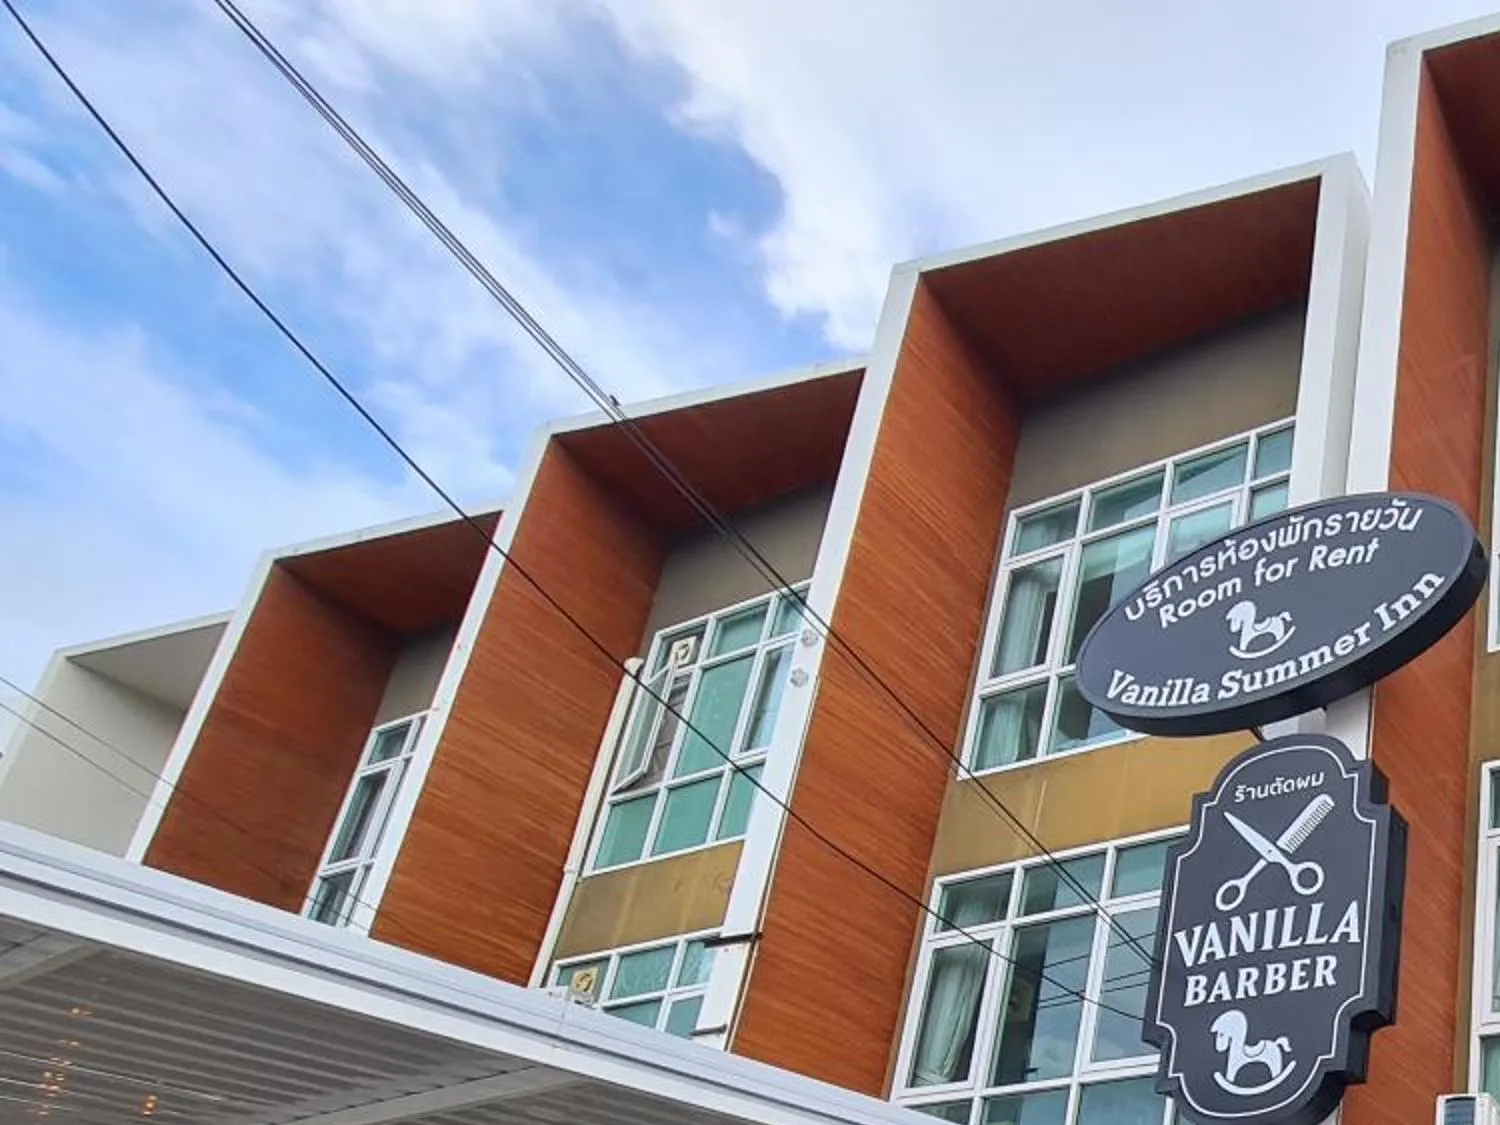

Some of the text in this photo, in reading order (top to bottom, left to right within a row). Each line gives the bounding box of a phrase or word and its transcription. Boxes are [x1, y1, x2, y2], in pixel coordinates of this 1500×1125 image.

[1123, 498, 1424, 623] บริการห้องพักรายวัน
[1159, 537, 1381, 629] Room for Rent
[1105, 570, 1445, 707] Vanilla Summer Inn
[1233, 769, 1326, 804] ร้านตัดผม
[1173, 900, 1361, 968] VANILLA
[1183, 954, 1338, 1008] BARBER
